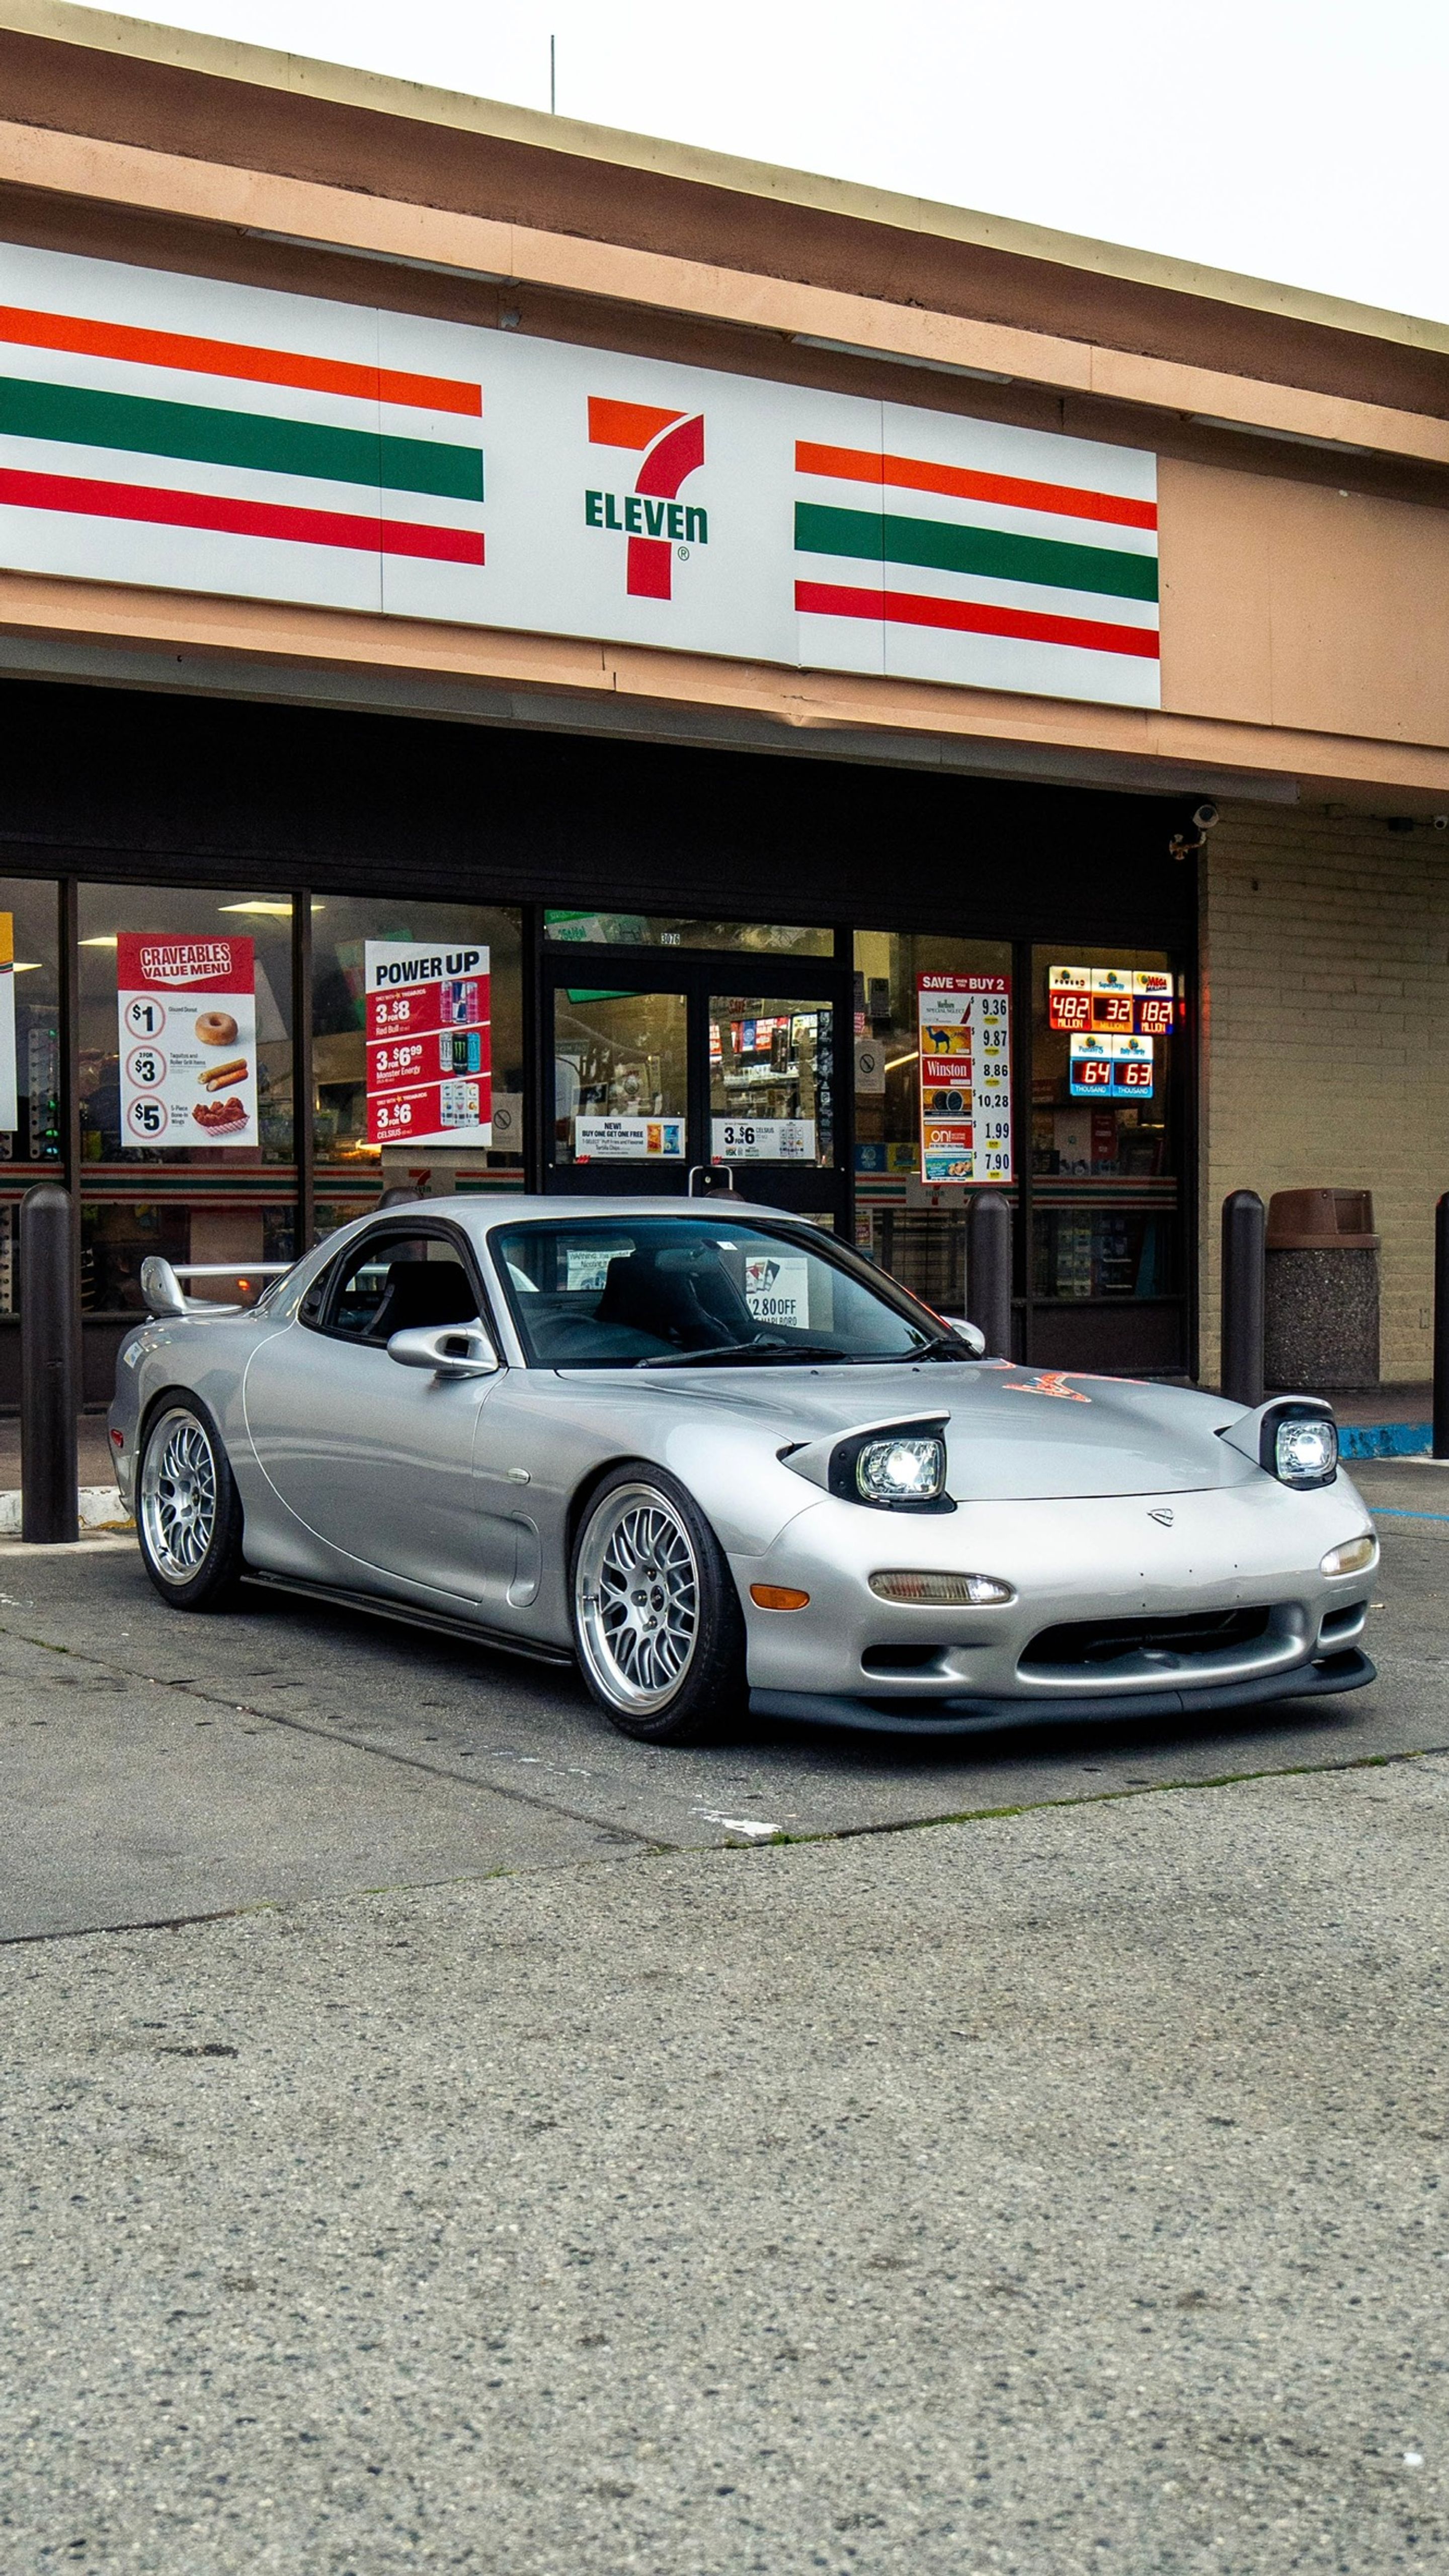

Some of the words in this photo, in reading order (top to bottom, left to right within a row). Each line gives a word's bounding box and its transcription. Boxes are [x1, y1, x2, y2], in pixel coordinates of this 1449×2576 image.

[587, 395, 704, 600] 7
[141, 944, 230, 966] CRAVEABLES
[143, 966, 188, 978] VALUE
[190, 963, 231, 975] MENU
[376, 956, 443, 986] POWER
[446, 951, 480, 975] UP
[923, 976, 954, 989] SAVE
[969, 978, 994, 990] BUY
[996, 979, 1005, 990] 2
[1147, 976, 1167, 986] MEGA
[376, 1003, 387, 1024] 3
[392, 1000, 410, 1020] $8
[983, 999, 1007, 1016] 9.36
[1053, 997, 1089, 1018] 482
[1107, 999, 1130, 1020] 32
[1142, 1001, 1171, 1022] 182
[132, 1004, 153, 1032] $1
[1058, 1018, 1083, 1028] MILLION
[984, 1029, 1007, 1047] 9.87
[376, 1050, 388, 1071] 3
[927, 1060, 968, 1077] Winston
[135, 1059, 155, 1082] $3
[984, 1064, 1008, 1077] 8.86
[1085, 1062, 1110, 1083] 64
[1126, 1063, 1151, 1084] 63
[978, 1094, 1009, 1109] 10.28
[135, 1103, 160, 1131] $5
[377, 1108, 389, 1128] 3
[393, 1104, 412, 1124] $6
[377, 1128, 402, 1139] CELSIUS
[725, 1127, 734, 1144] 3
[740, 1126, 755, 1144] $6
[985, 1123, 1010, 1139] 1.99
[985, 1154, 1010, 1170] 7.90
[777, 1299, 796, 1315] OFF
